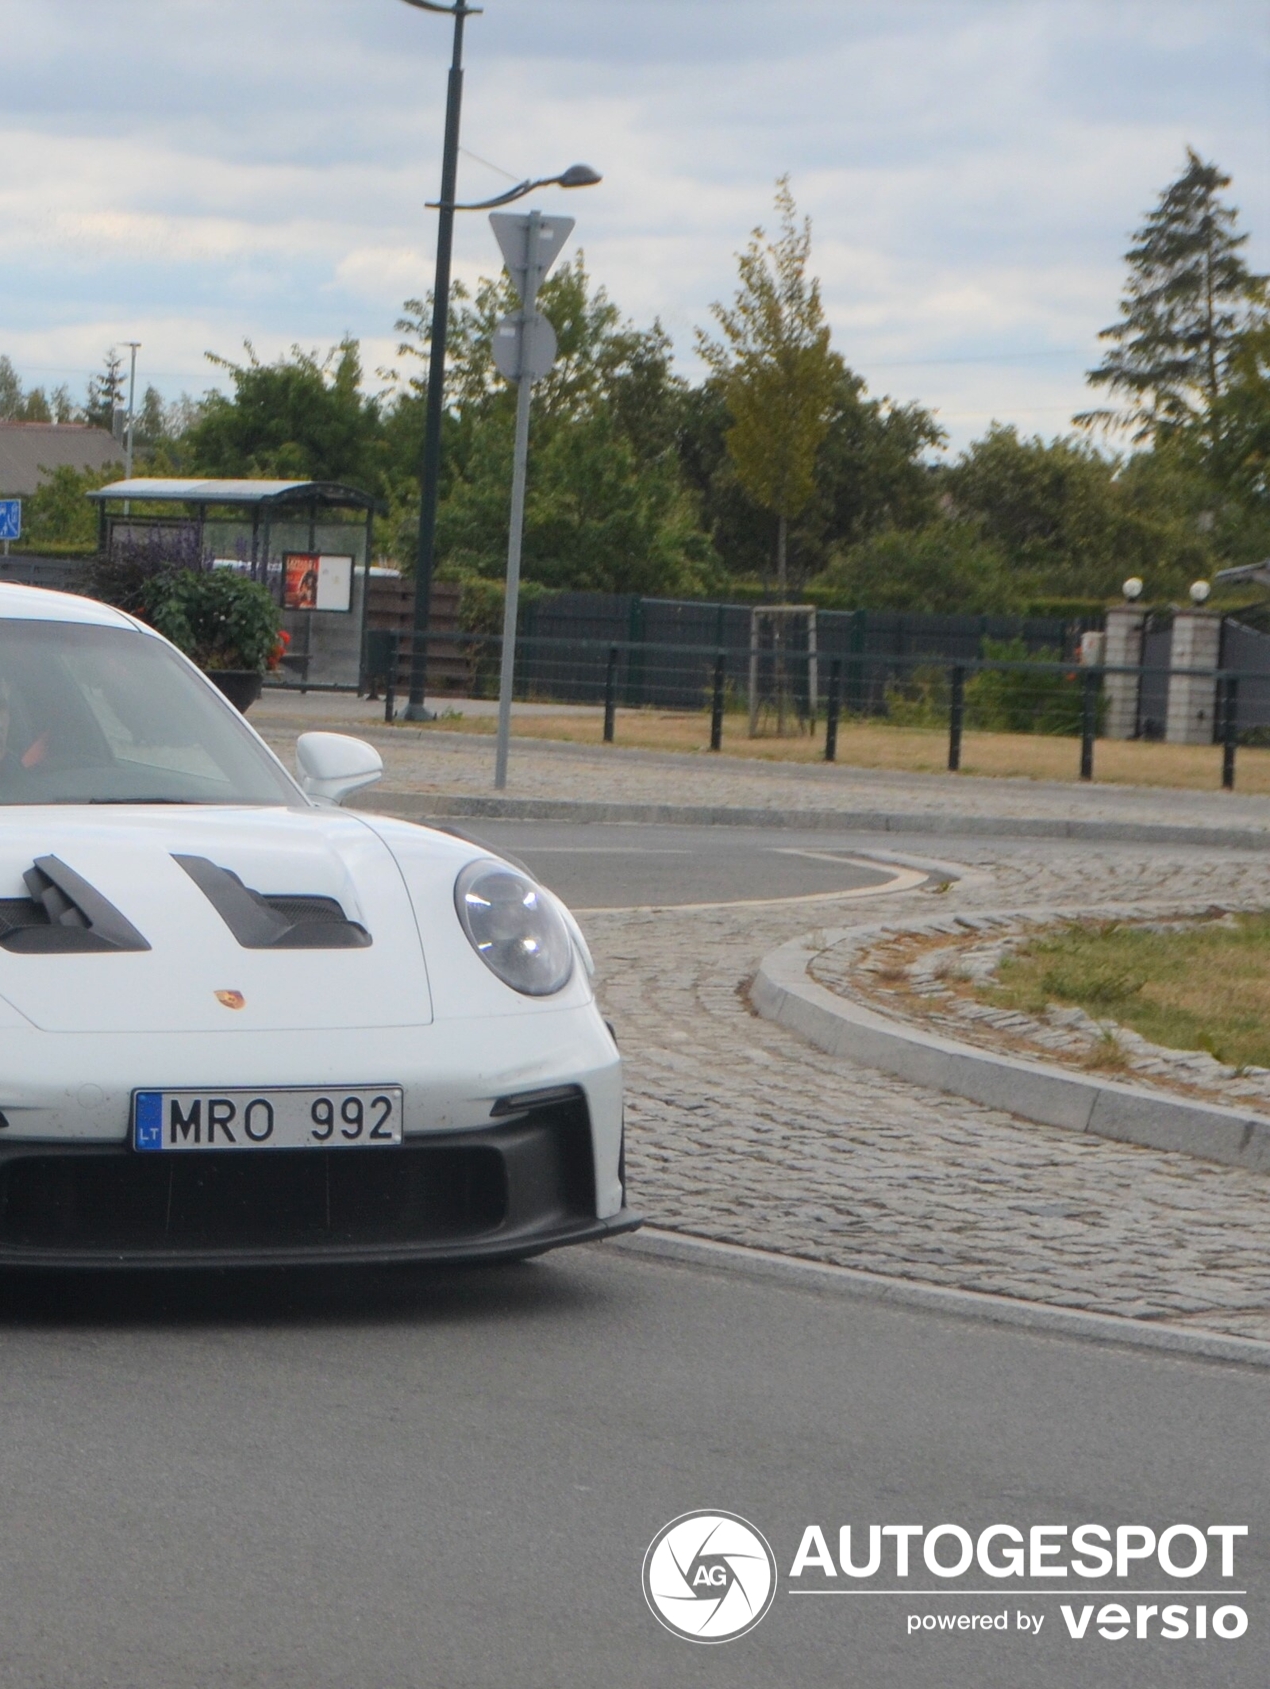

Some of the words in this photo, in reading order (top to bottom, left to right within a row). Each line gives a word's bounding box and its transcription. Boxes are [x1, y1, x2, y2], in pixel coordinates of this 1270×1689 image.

[140, 1127, 159, 1140] LT
[170, 1098, 275, 1143] MRO
[310, 1096, 393, 1141] 992
